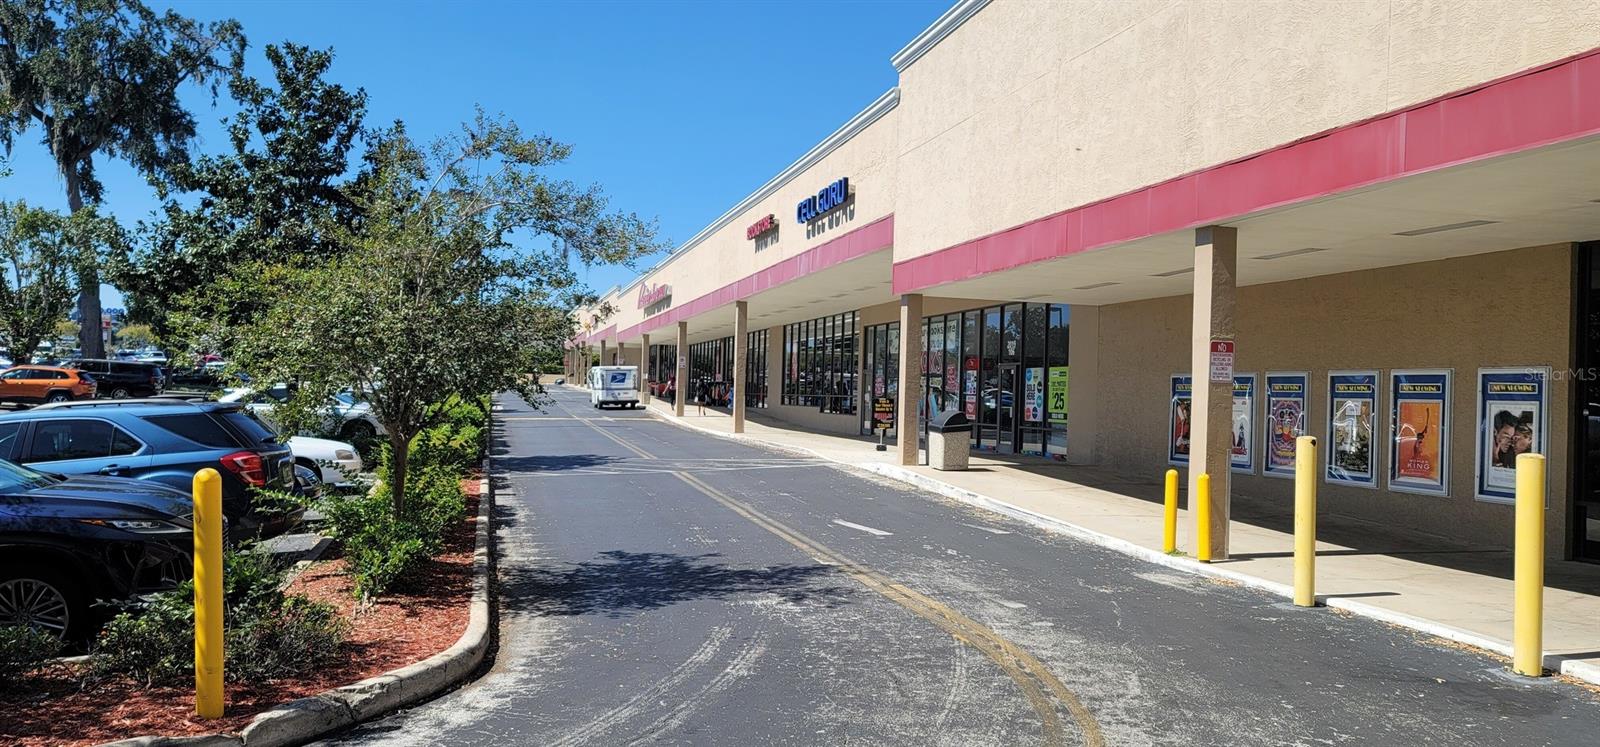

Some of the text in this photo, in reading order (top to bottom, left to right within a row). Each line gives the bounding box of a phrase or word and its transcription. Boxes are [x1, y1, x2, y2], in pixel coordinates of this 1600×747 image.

[796, 177, 849, 224] CELL GURU
[1217, 343, 1227, 352] NO
